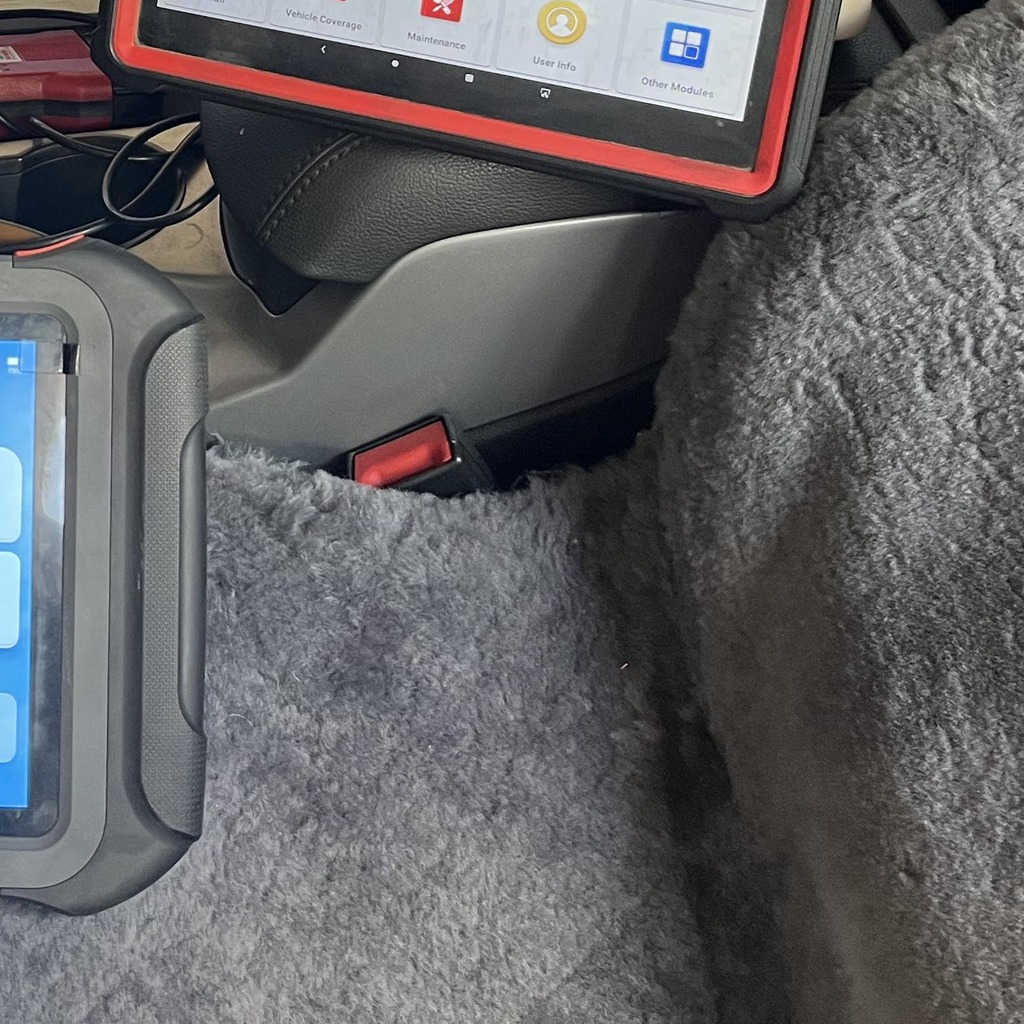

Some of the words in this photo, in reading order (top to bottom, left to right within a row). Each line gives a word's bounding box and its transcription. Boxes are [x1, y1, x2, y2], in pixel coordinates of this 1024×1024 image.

[285, 8, 318, 22] Vehicle
[319, 15, 363, 32] Coverage
[407, 32, 467, 52] Maintenance
[532, 55, 555, 68] User
[556, 59, 577, 73] Info
[641, 77, 669, 90] Other
[670, 82, 715, 99] Modules
